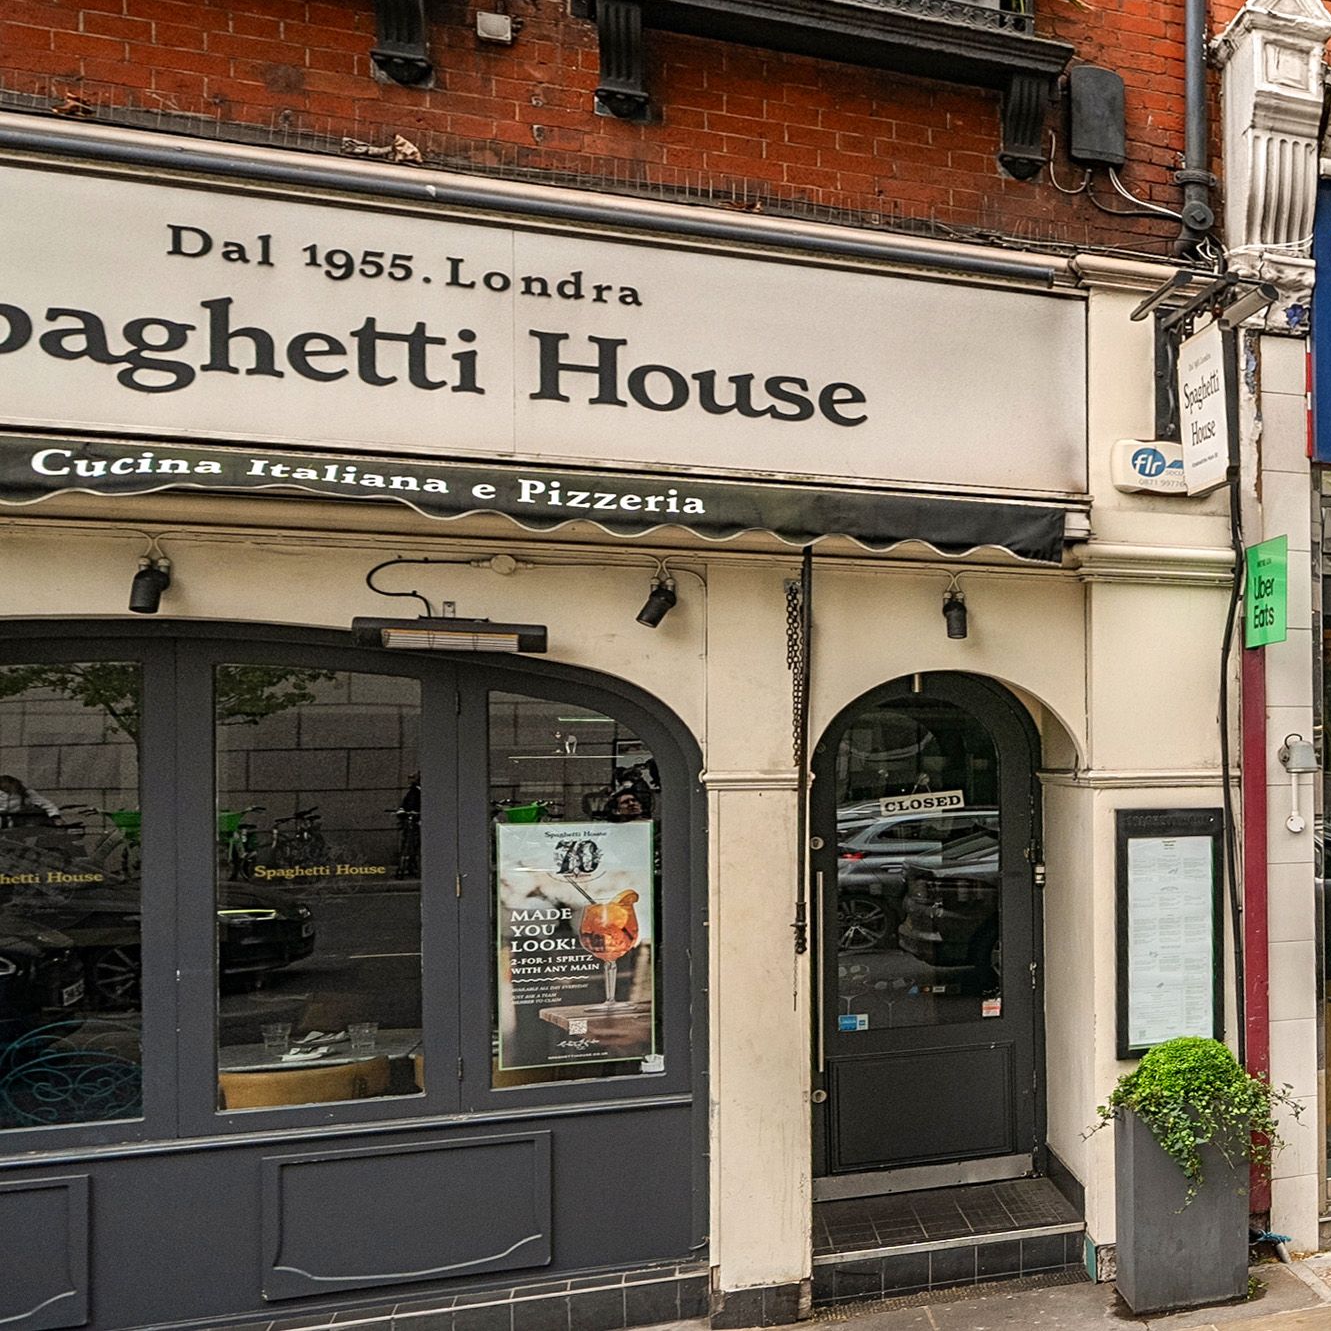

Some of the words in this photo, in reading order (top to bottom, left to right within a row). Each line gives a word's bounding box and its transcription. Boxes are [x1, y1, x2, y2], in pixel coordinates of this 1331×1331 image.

[167, 225, 274, 268] Dal
[529, 330, 868, 426] House
[1183, 369, 1220, 415] Spaghetti
[1191, 420, 1216, 446] House
[31, 449, 222, 478] Cucina
[246, 460, 449, 495] Italiana
[473, 481, 496, 500] e
[518, 479, 705, 515] Pizzeria
[1253, 575, 1275, 600] Uber
[1253, 604, 1275, 628] Eats
[884, 794, 962, 812] CLOSED
[47, 871, 104, 883] House
[254, 865, 330, 880] Spaghetti
[336, 864, 386, 875] House
[510, 908, 573, 922] MADE
[510, 924, 556, 937] YOU
[511, 938, 576, 953] LOOK!
[510, 957, 553, 966] 2-FOR-1
[556, 954, 594, 963] SPRITZ
[544, 965, 568, 973] ANY
[570, 963, 600, 971] MAIN
